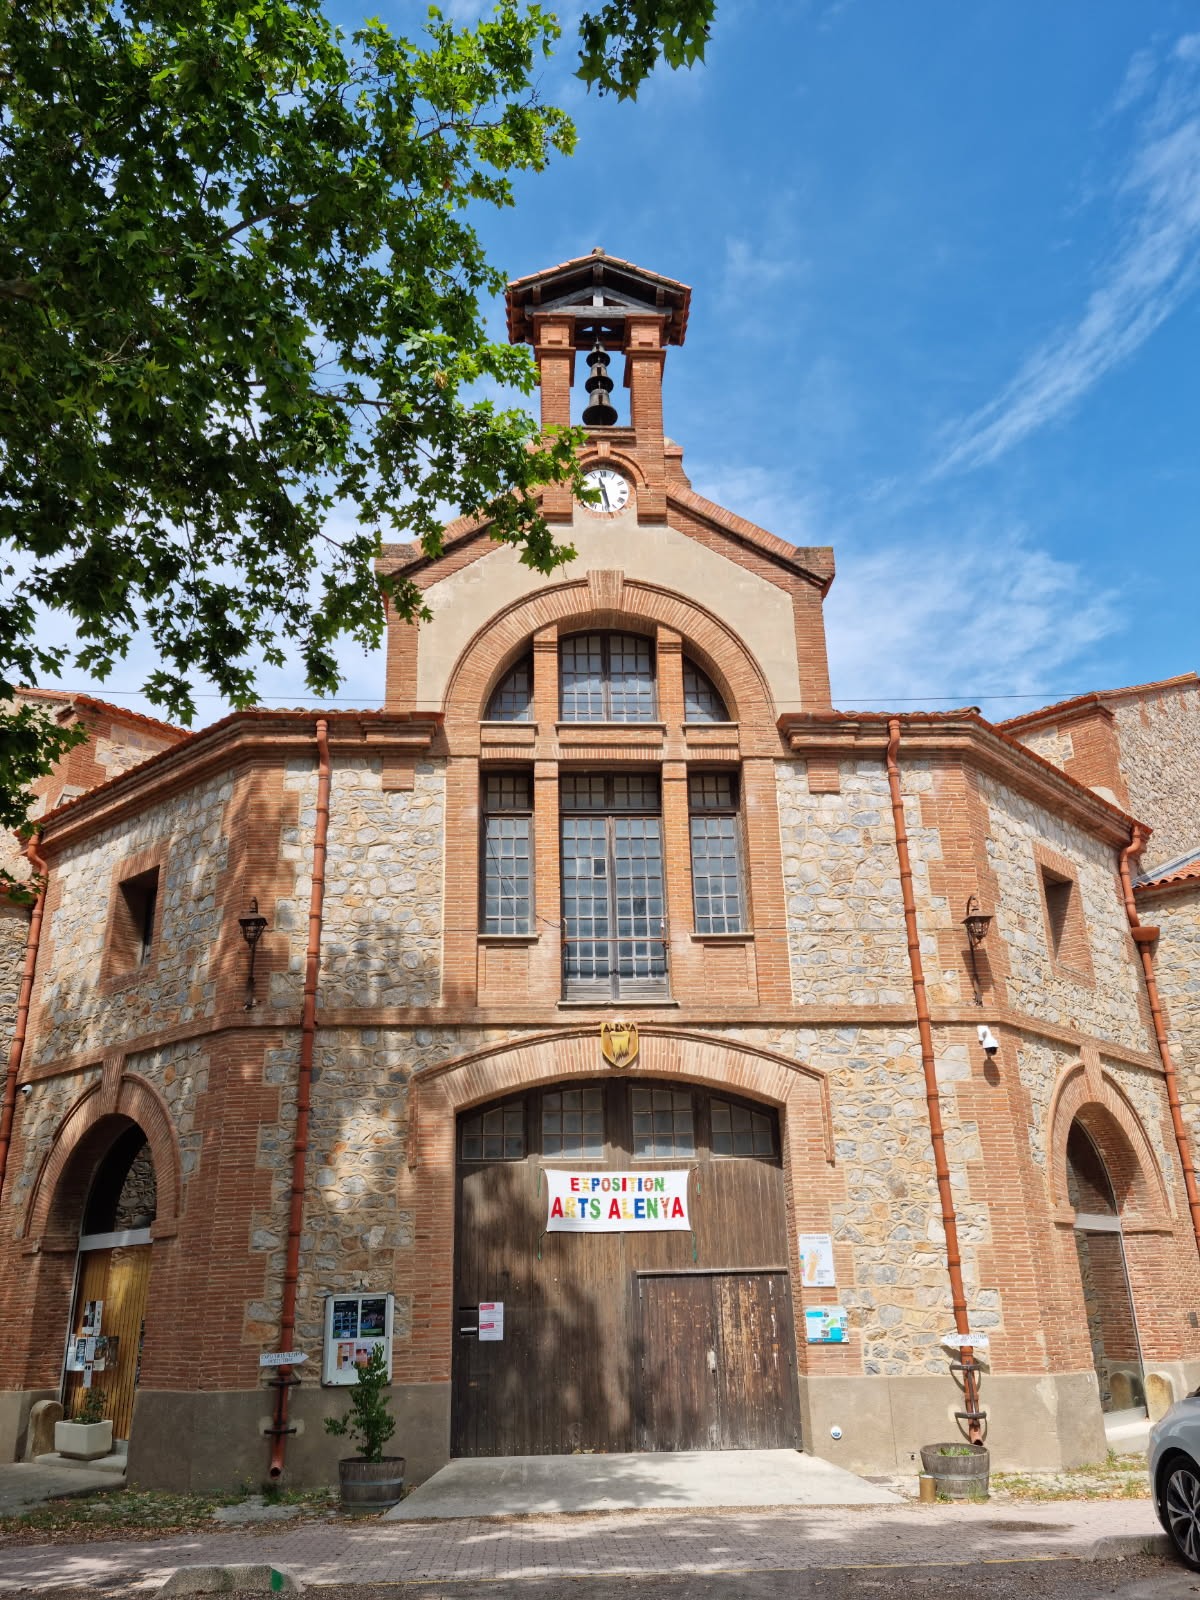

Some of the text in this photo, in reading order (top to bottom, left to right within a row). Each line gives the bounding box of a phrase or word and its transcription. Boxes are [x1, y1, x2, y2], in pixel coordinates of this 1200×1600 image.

[604, 1024, 636, 1032] ALENYA
[570, 1177, 665, 1192] EXPOSITION
[551, 1197, 685, 1219] ARTS ALENYA
